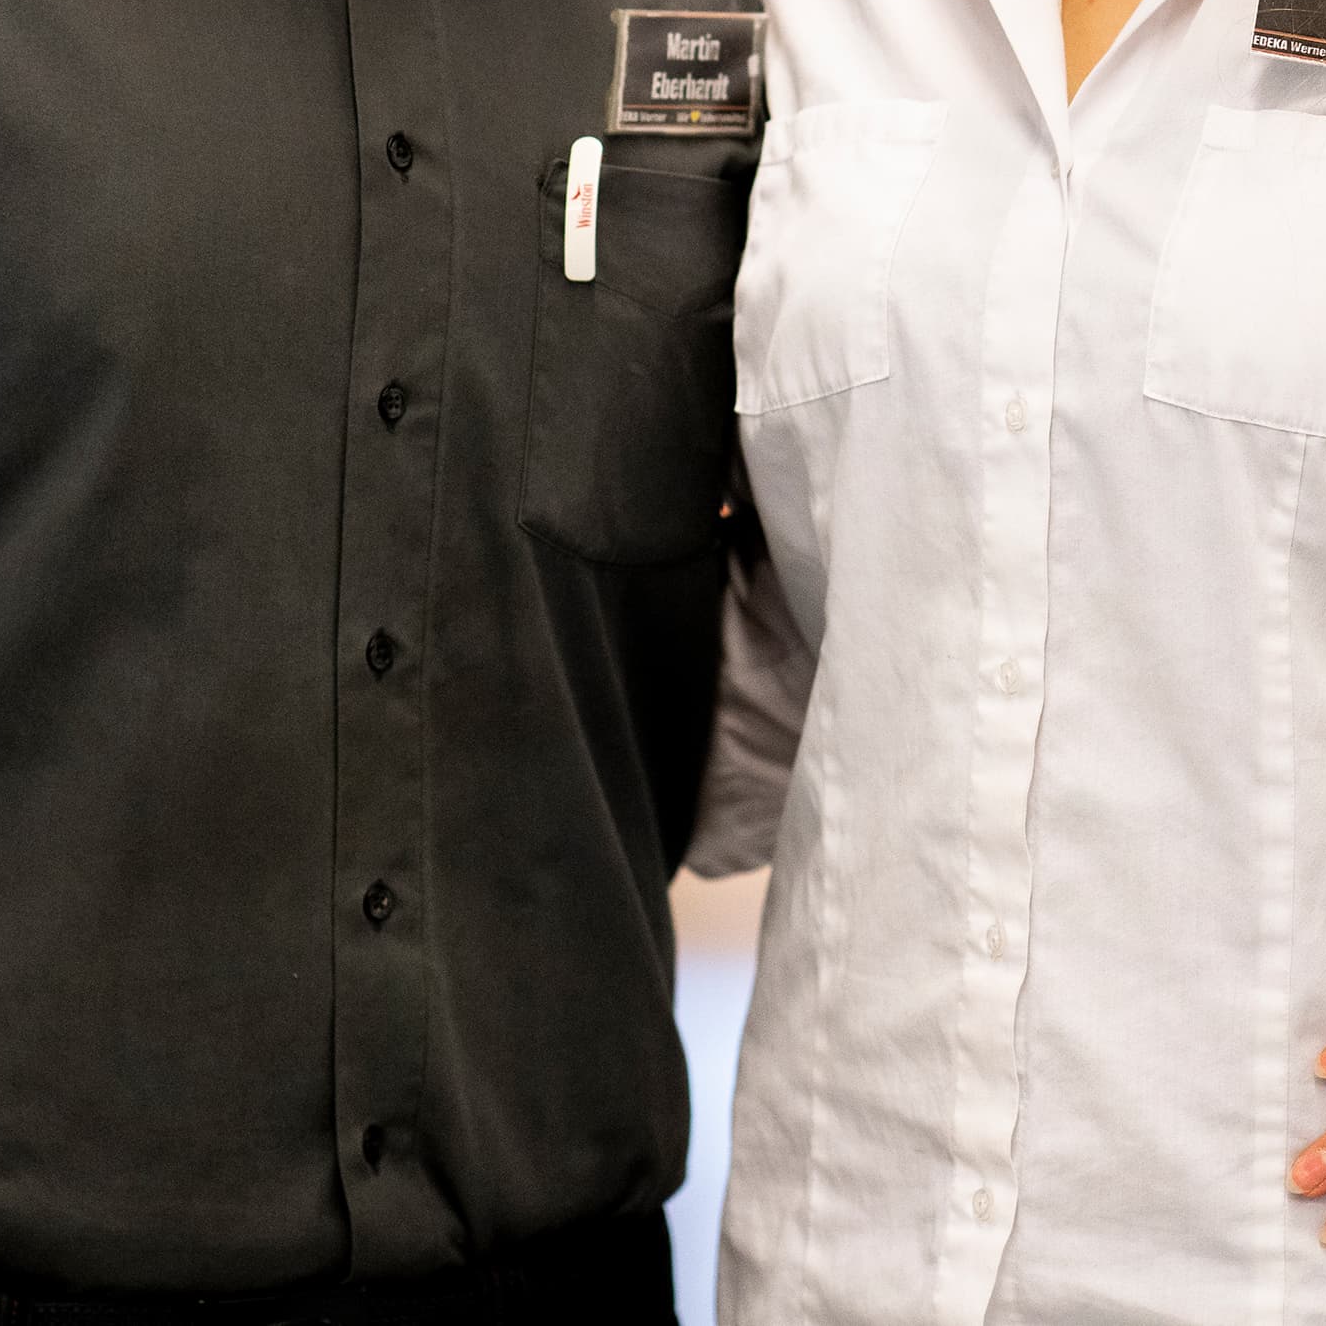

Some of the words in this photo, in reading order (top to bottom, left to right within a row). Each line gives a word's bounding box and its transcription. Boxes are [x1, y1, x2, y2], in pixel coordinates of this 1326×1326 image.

[666, 32, 721, 62] Martin
[1253, 34, 1288, 51] EDEKA
[651, 71, 730, 101] Eberhardt
[576, 184, 594, 228] Winston
